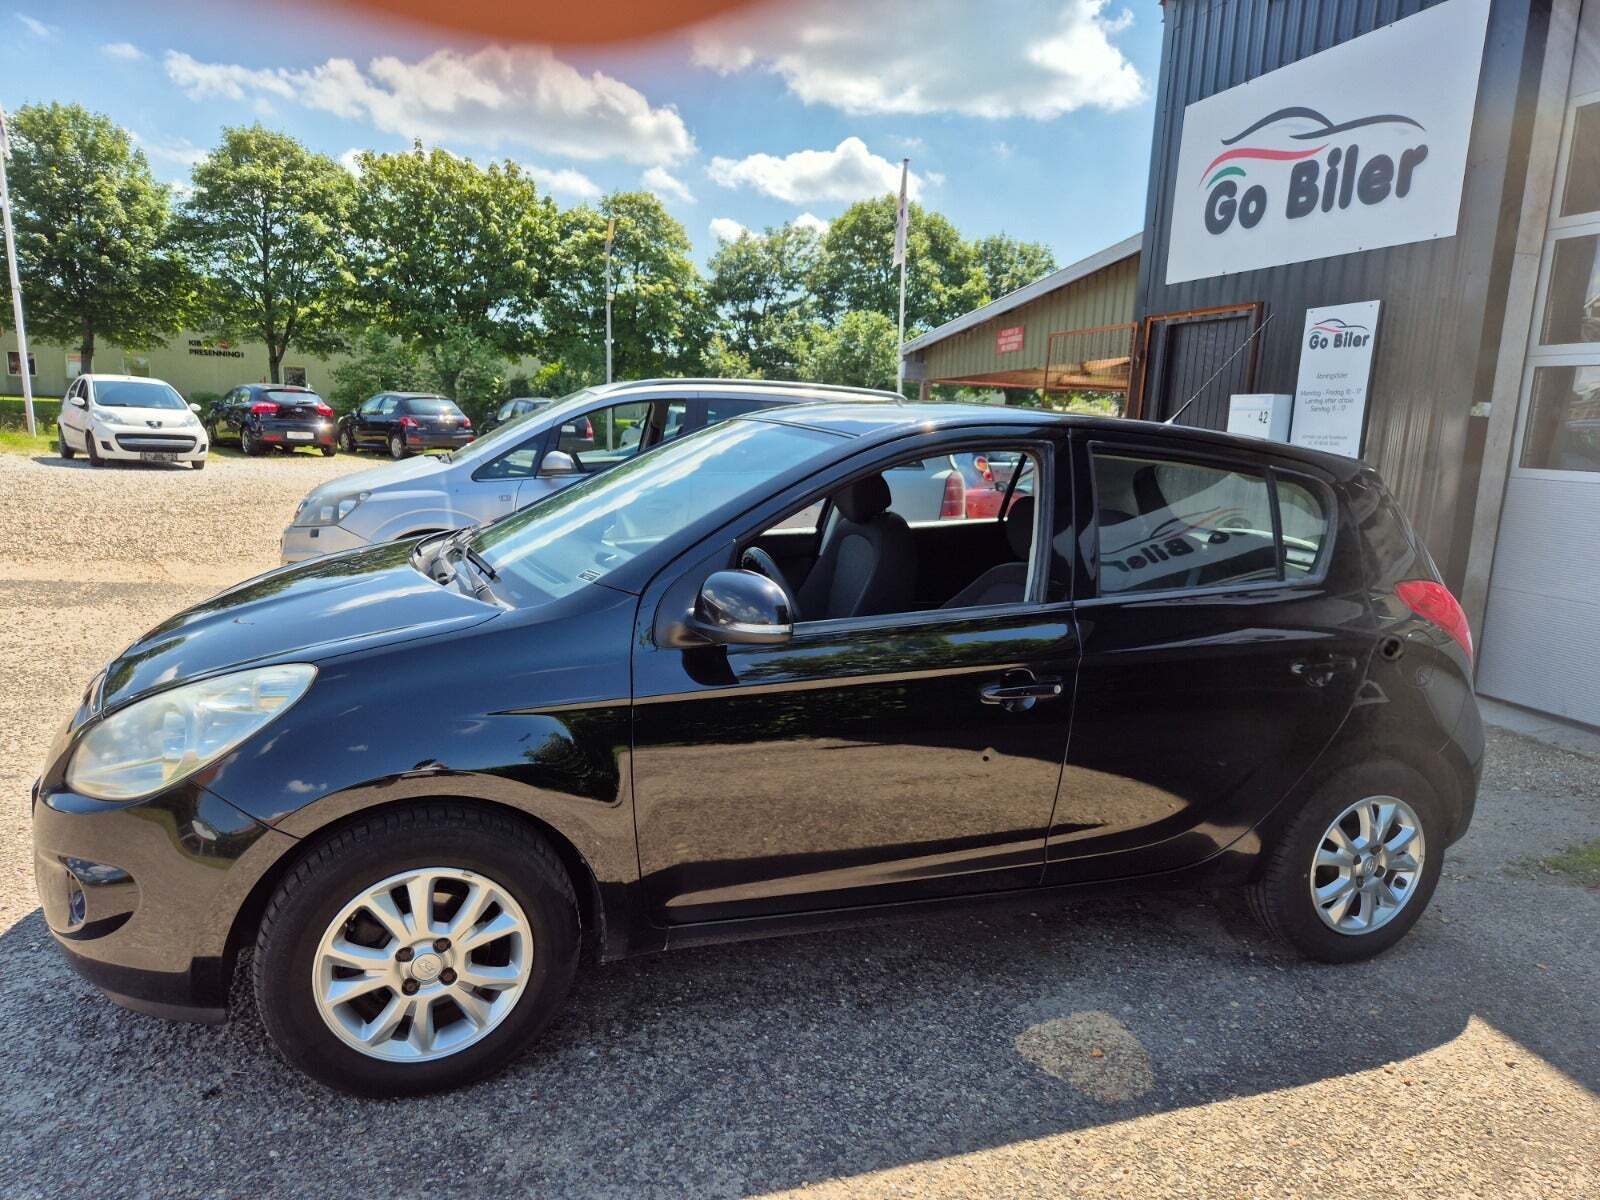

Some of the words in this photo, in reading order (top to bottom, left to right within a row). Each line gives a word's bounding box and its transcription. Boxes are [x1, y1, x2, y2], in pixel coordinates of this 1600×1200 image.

[1204, 180, 1267, 235] Go
[1285, 143, 1429, 220] Biler
[1309, 334, 1329, 350] Go
[1333, 331, 1370, 348] Biler
[1258, 410, 1268, 424] 42
